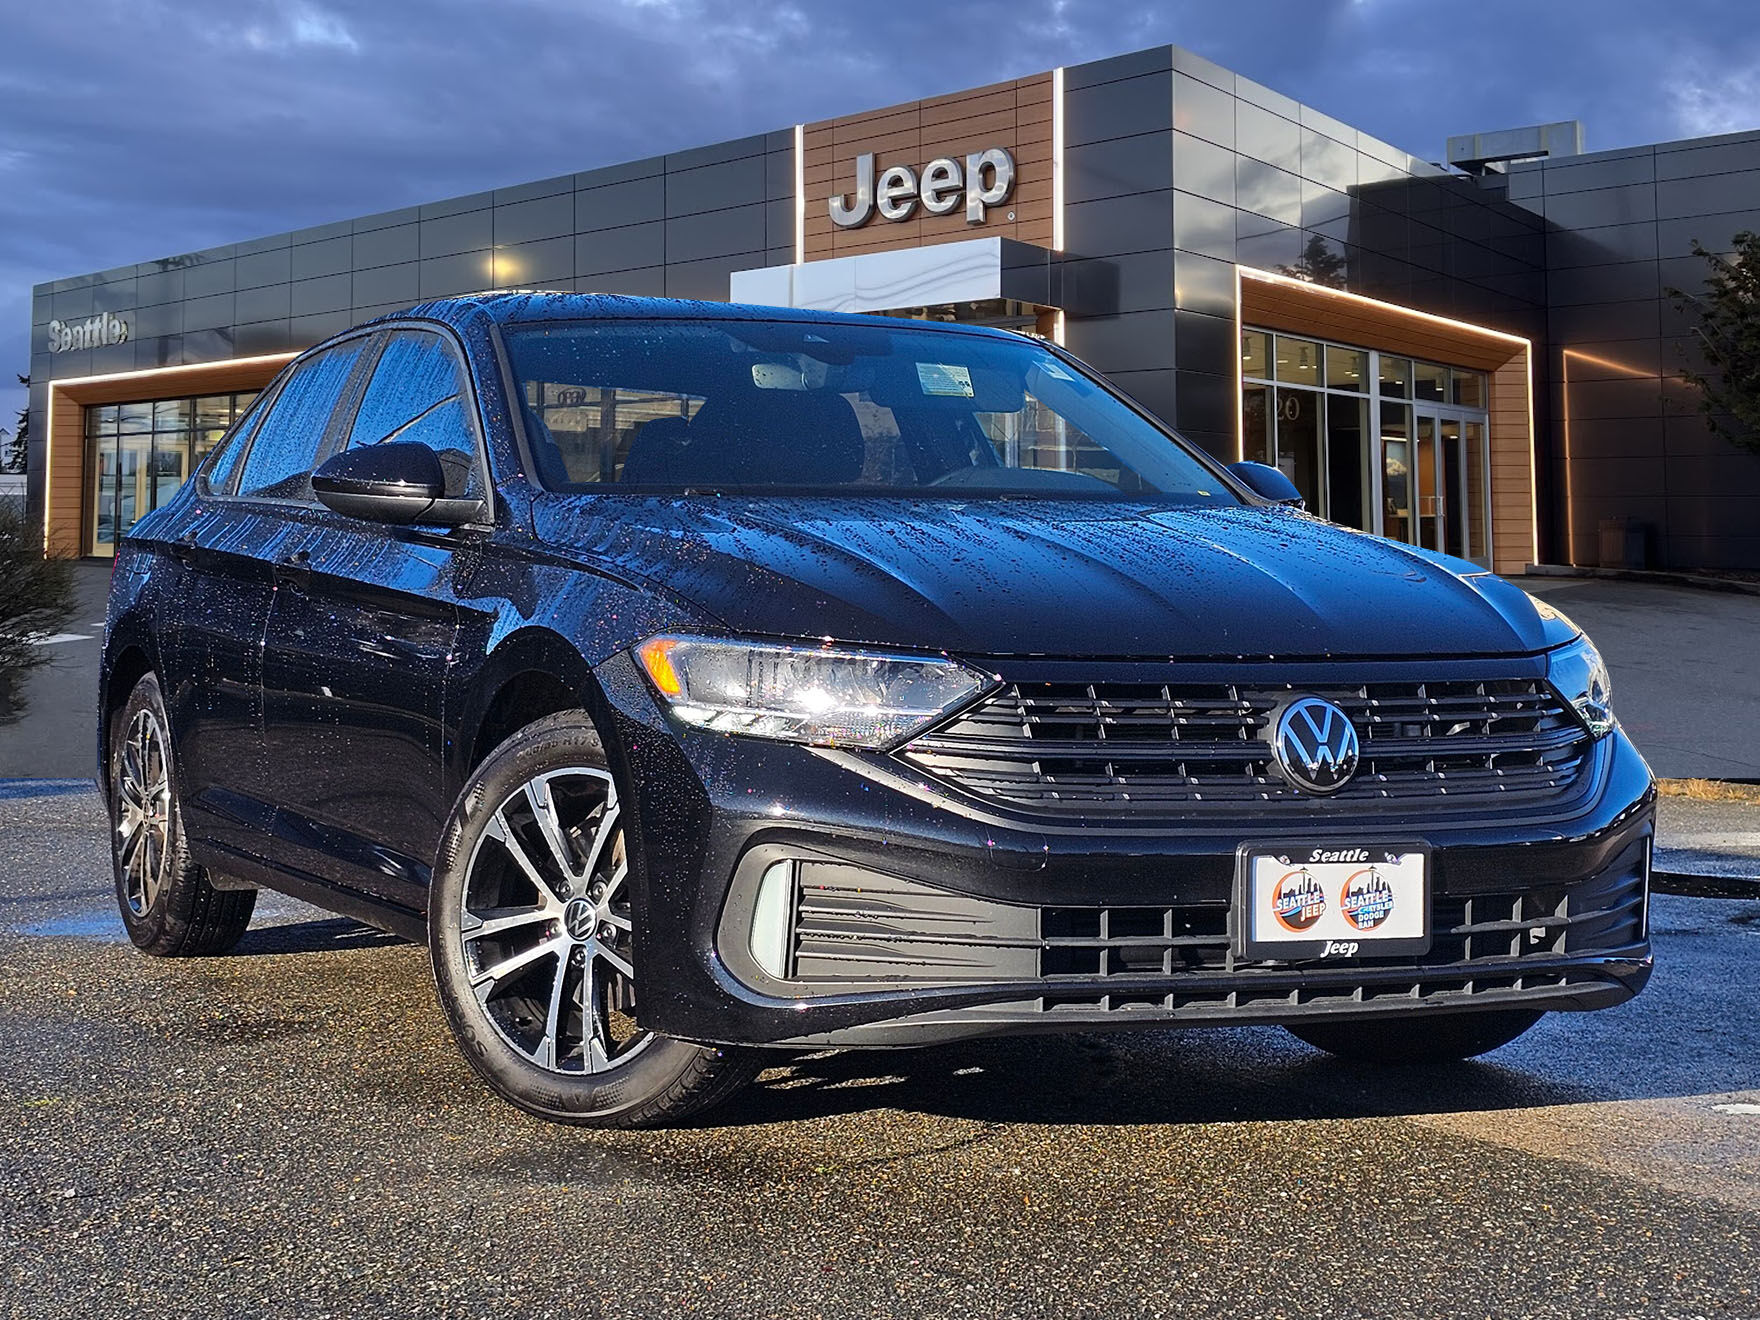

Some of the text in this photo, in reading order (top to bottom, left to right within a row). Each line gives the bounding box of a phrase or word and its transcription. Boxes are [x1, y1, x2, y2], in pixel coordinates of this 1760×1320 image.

[829, 148, 1016, 228] Jeep
[48, 312, 128, 353] Seattle
[1309, 848, 1369, 863] Seattle
[1276, 892, 1320, 911] SEATTLE
[1345, 890, 1389, 909] SEATTLE
[1300, 903, 1326, 922] JEEP
[1358, 911, 1385, 922] DODGE
[1358, 919, 1374, 929] RAM
[1320, 940, 1359, 958] Jeep
